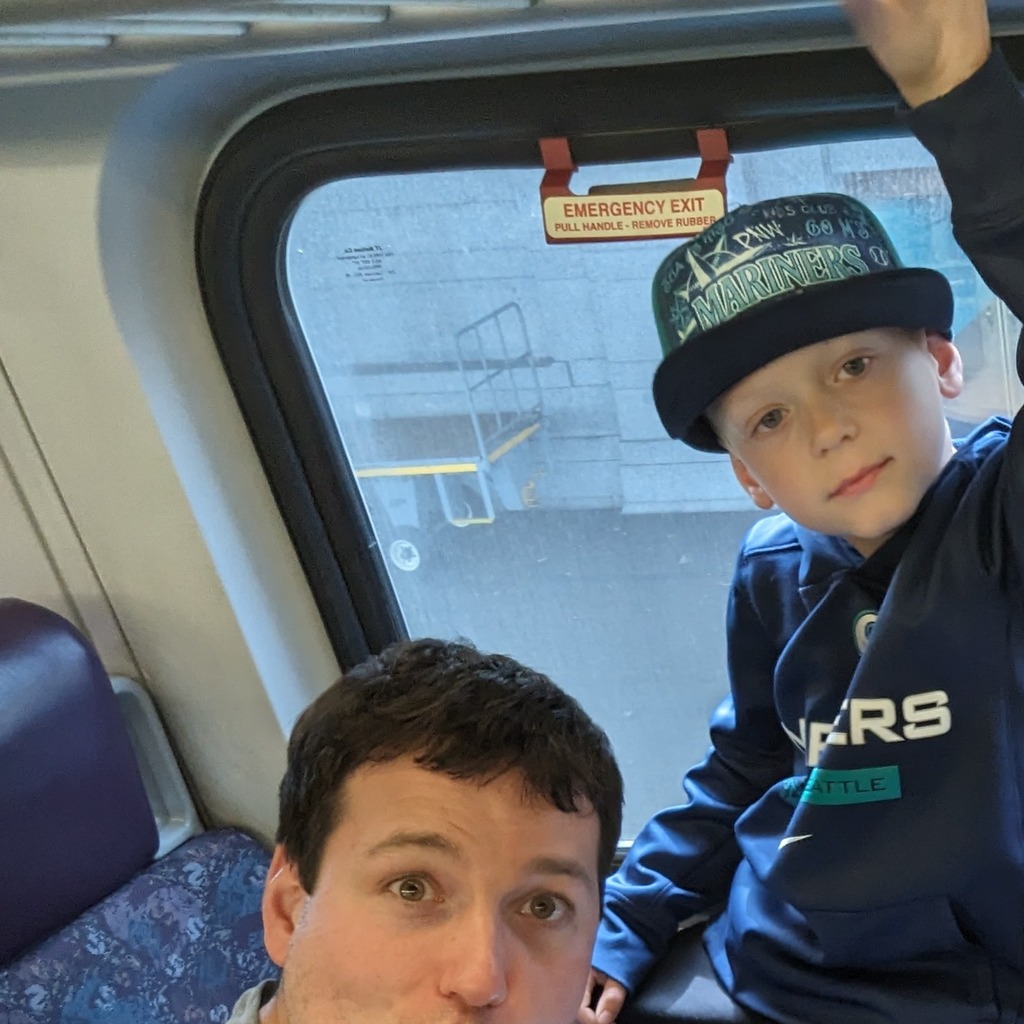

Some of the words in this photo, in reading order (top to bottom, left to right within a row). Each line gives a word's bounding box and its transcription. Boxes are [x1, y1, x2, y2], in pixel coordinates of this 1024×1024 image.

[563, 199, 665, 218] EMERGENCY
[670, 197, 704, 213] EXIT
[555, 222, 580, 231] PULL
[583, 221, 623, 231] HANDLE
[632, 218, 673, 229] REMOVE
[675, 215, 717, 227] RUBBER
[805, 218, 834, 237] GO
[733, 219, 785, 250] PNW
[690, 243, 870, 333] MARINERS
